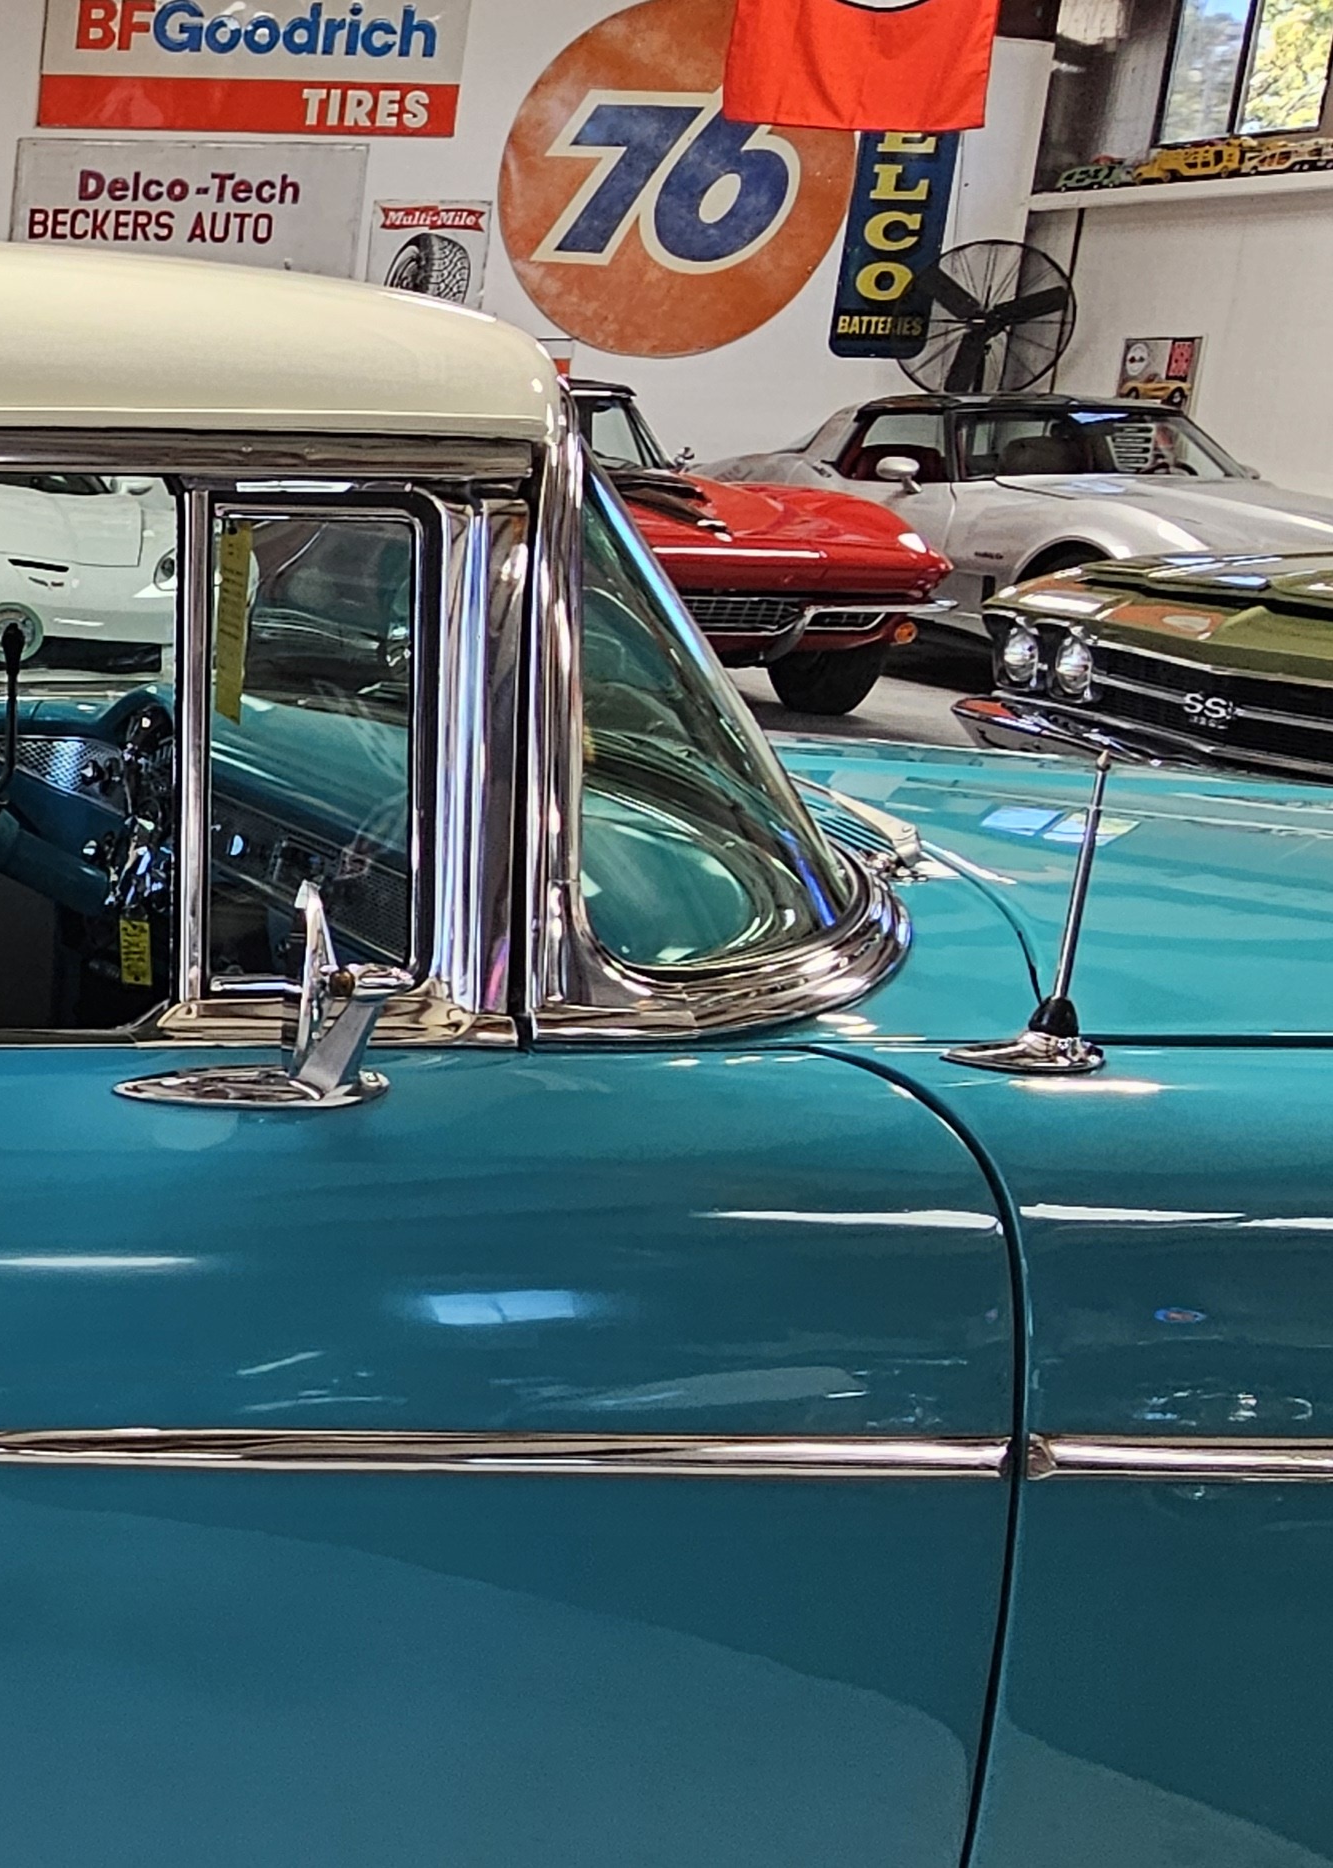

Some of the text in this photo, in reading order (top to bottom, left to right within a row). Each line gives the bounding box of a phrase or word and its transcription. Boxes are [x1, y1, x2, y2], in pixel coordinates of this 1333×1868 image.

[76, 0, 437, 58] BFGoodrich
[301, 88, 429, 129] TIRES
[531, 88, 800, 274] 76
[27, 208, 273, 245] BECKERS AUTO
[385, 210, 478, 226] Multi-Mile
[1183, 692, 1228, 719] SS
